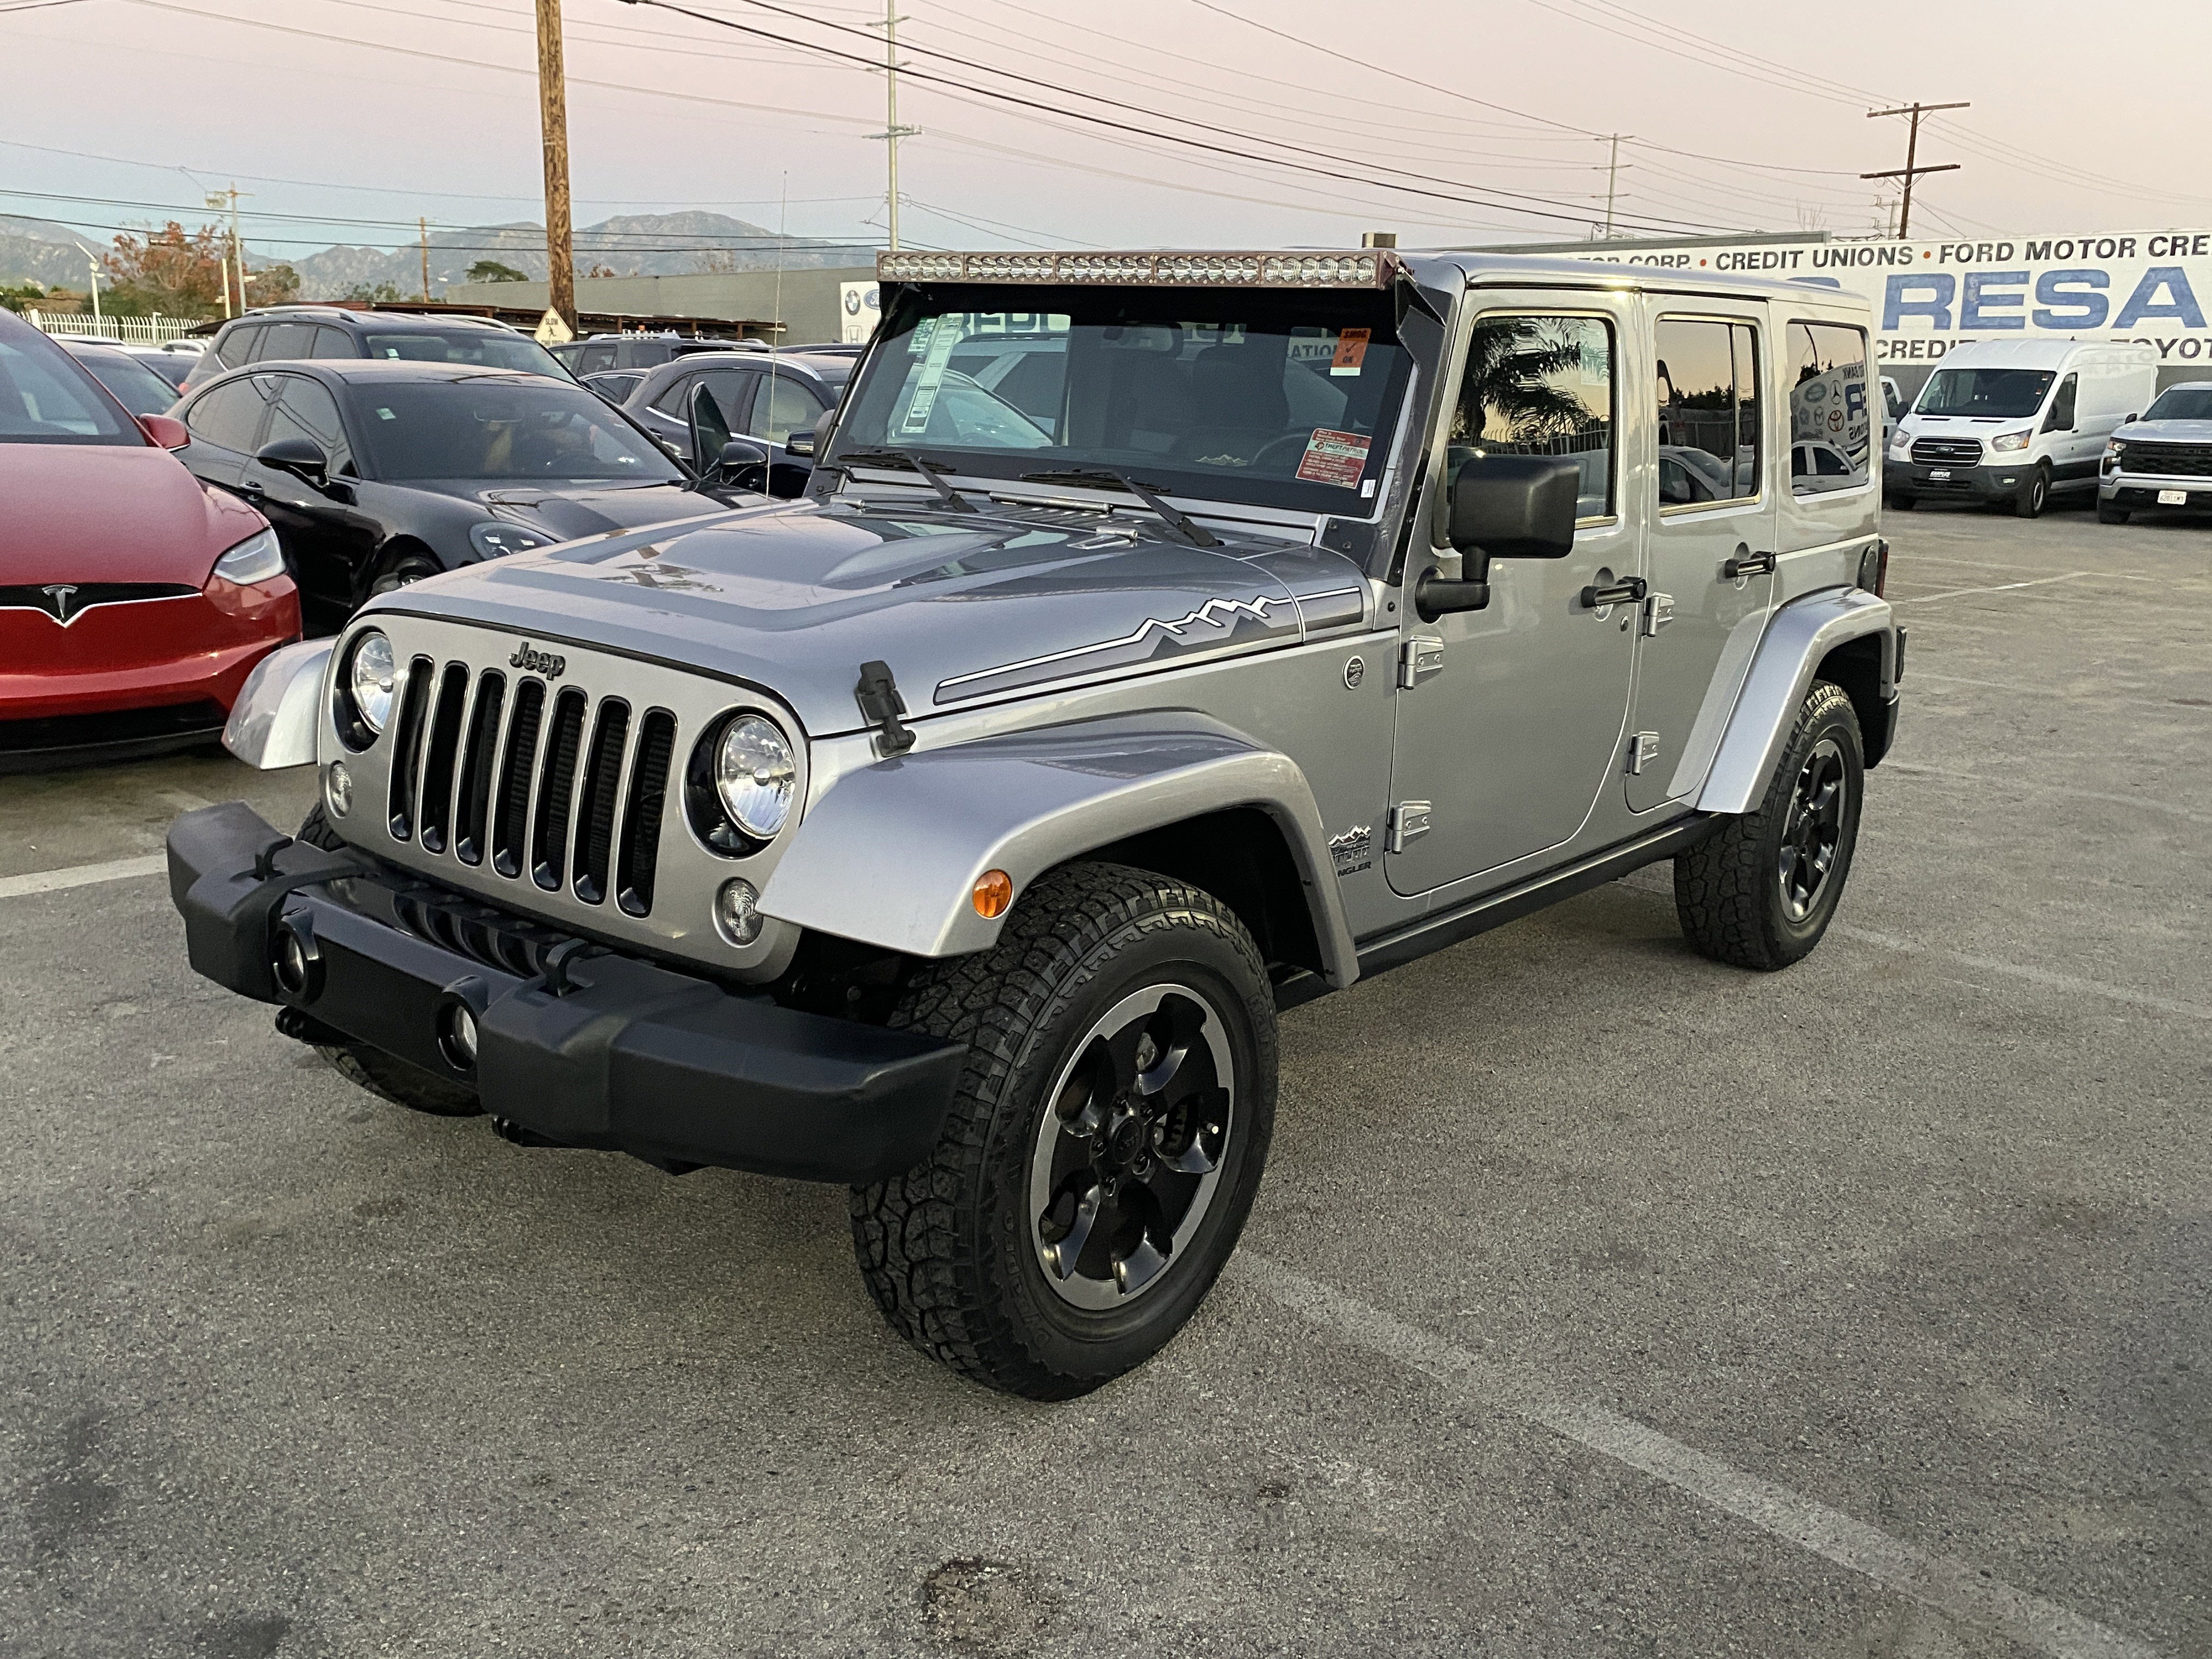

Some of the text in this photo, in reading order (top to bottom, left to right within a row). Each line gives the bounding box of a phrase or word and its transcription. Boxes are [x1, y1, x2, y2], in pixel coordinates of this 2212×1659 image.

[1716, 250, 1804, 270] CREDIT
[1812, 246, 1913, 268] UNIONS
[1939, 242, 2015, 264] FORD
[2024, 238, 2137, 261] MOTOR
[2148, 234, 2212, 257] CRE
[1882, 266, 2208, 330] RESA
[1344, 330, 1367, 338] SMOG
[1876, 338, 2212, 359] CRED YOT
[508, 641, 566, 681] Jeep
